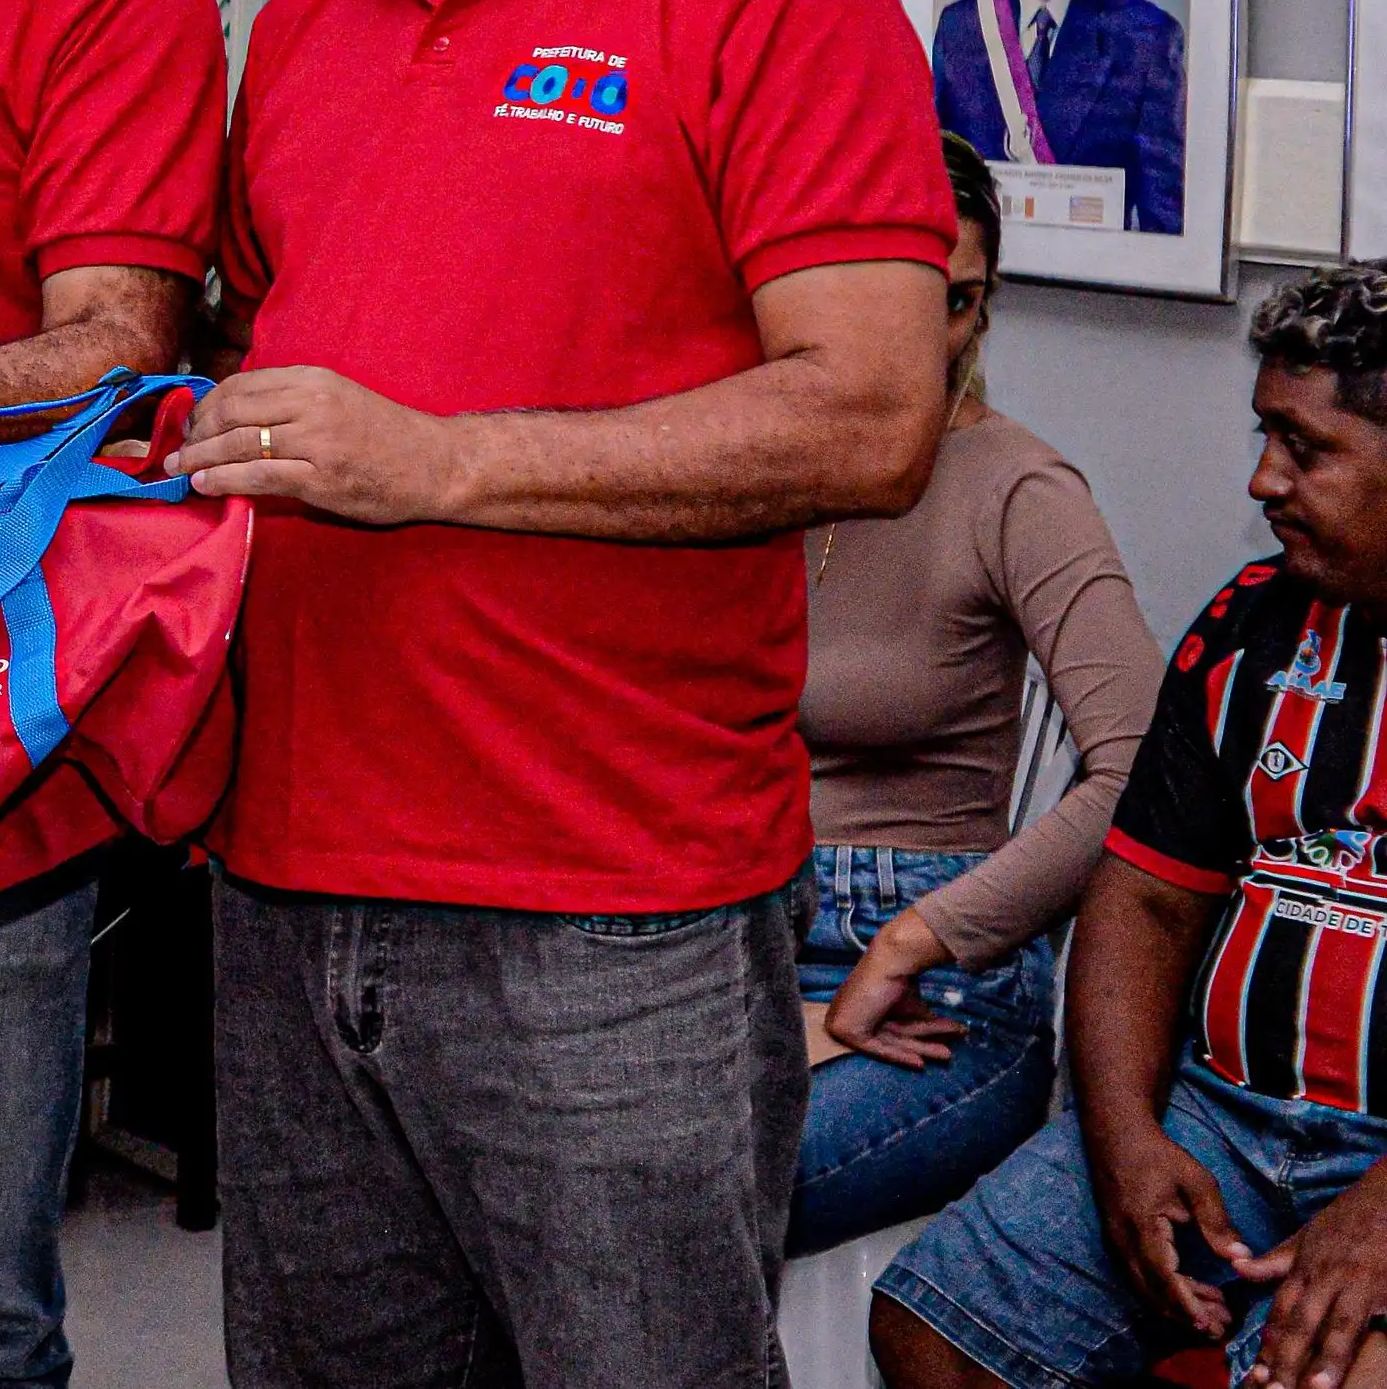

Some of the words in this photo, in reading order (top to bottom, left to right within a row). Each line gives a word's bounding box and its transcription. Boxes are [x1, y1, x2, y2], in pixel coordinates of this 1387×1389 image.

[532, 45, 605, 63] PREFEITURA
[607, 54, 628, 68] DE
[509, 105, 565, 122] TRABALHO
[566, 113, 577, 125] E
[578, 115, 625, 136] FUTURO
[1276, 900, 1341, 928] CIDADE
[1346, 916, 1374, 935] DE
